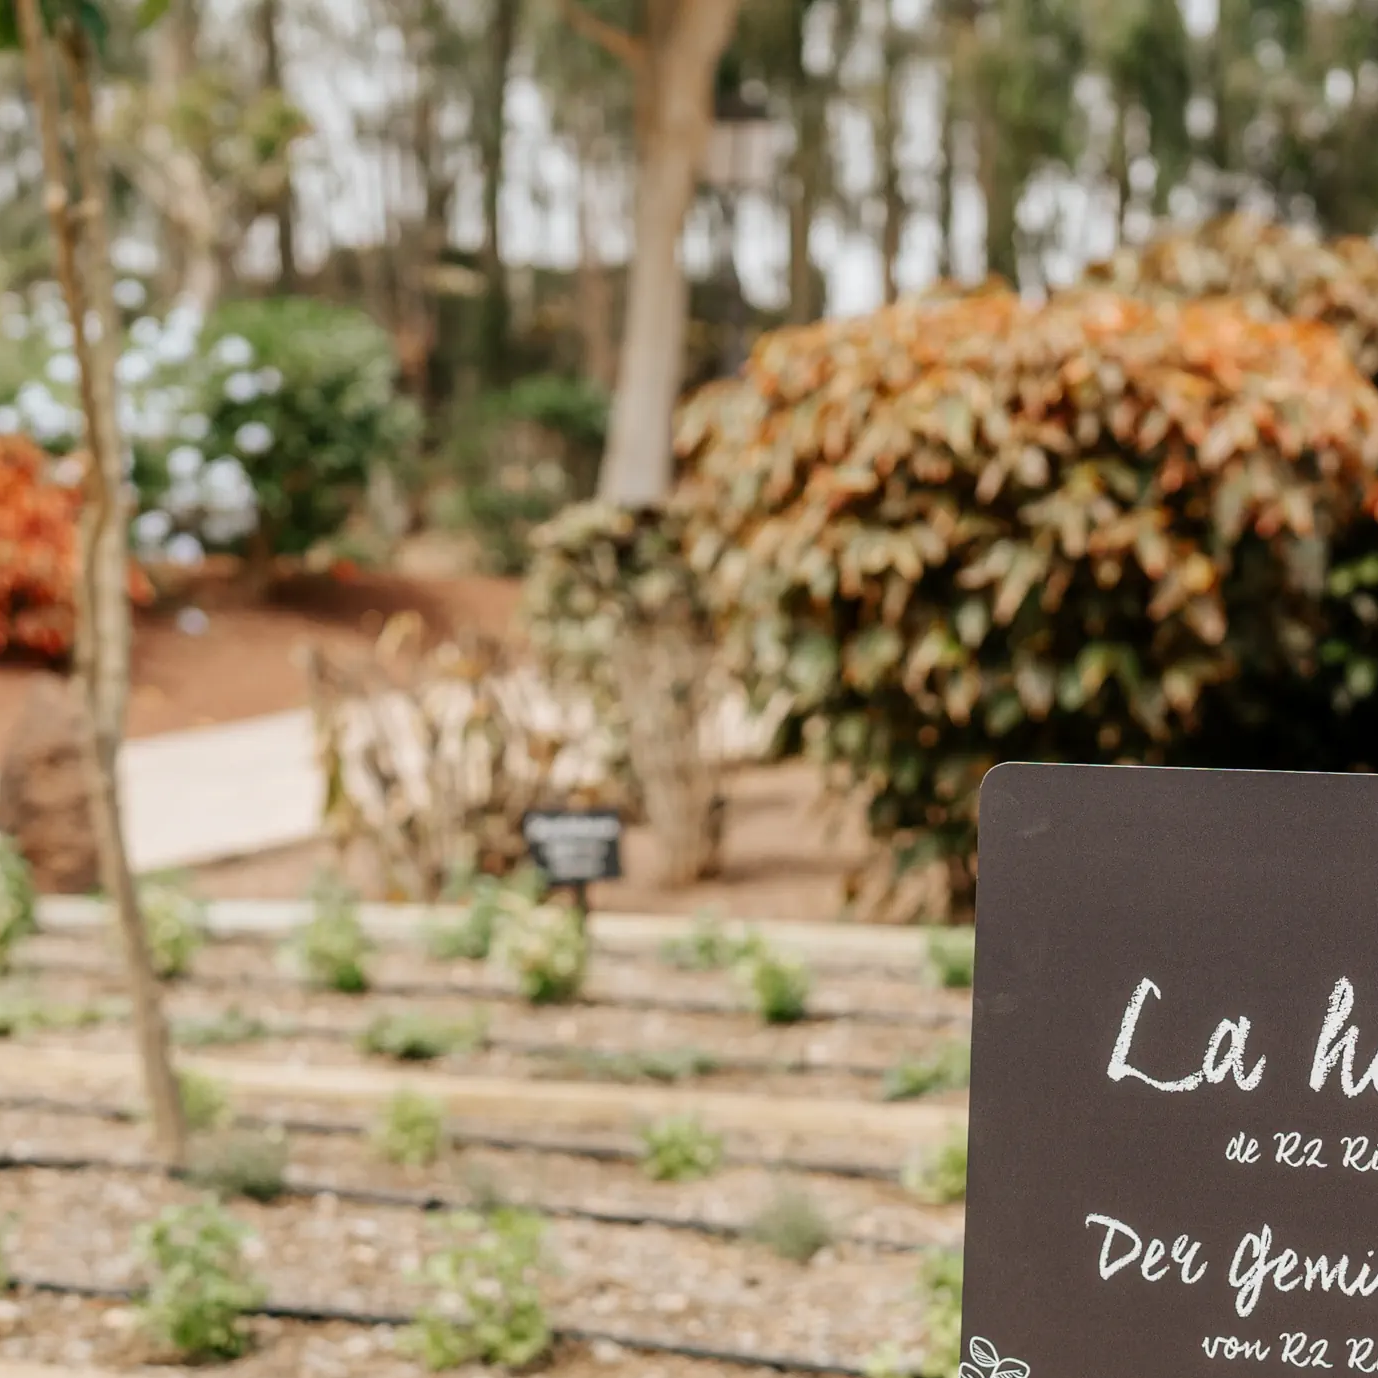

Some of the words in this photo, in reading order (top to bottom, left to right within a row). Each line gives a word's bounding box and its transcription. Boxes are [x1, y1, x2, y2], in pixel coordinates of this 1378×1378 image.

[1106, 977, 1267, 1093] La
[1225, 1131, 1262, 1164] de
[1272, 1131, 1328, 1168] R2
[1084, 1212, 1209, 1285] Der
[1201, 1334, 1271, 1362] von
[1279, 1331, 1334, 1369] R2
